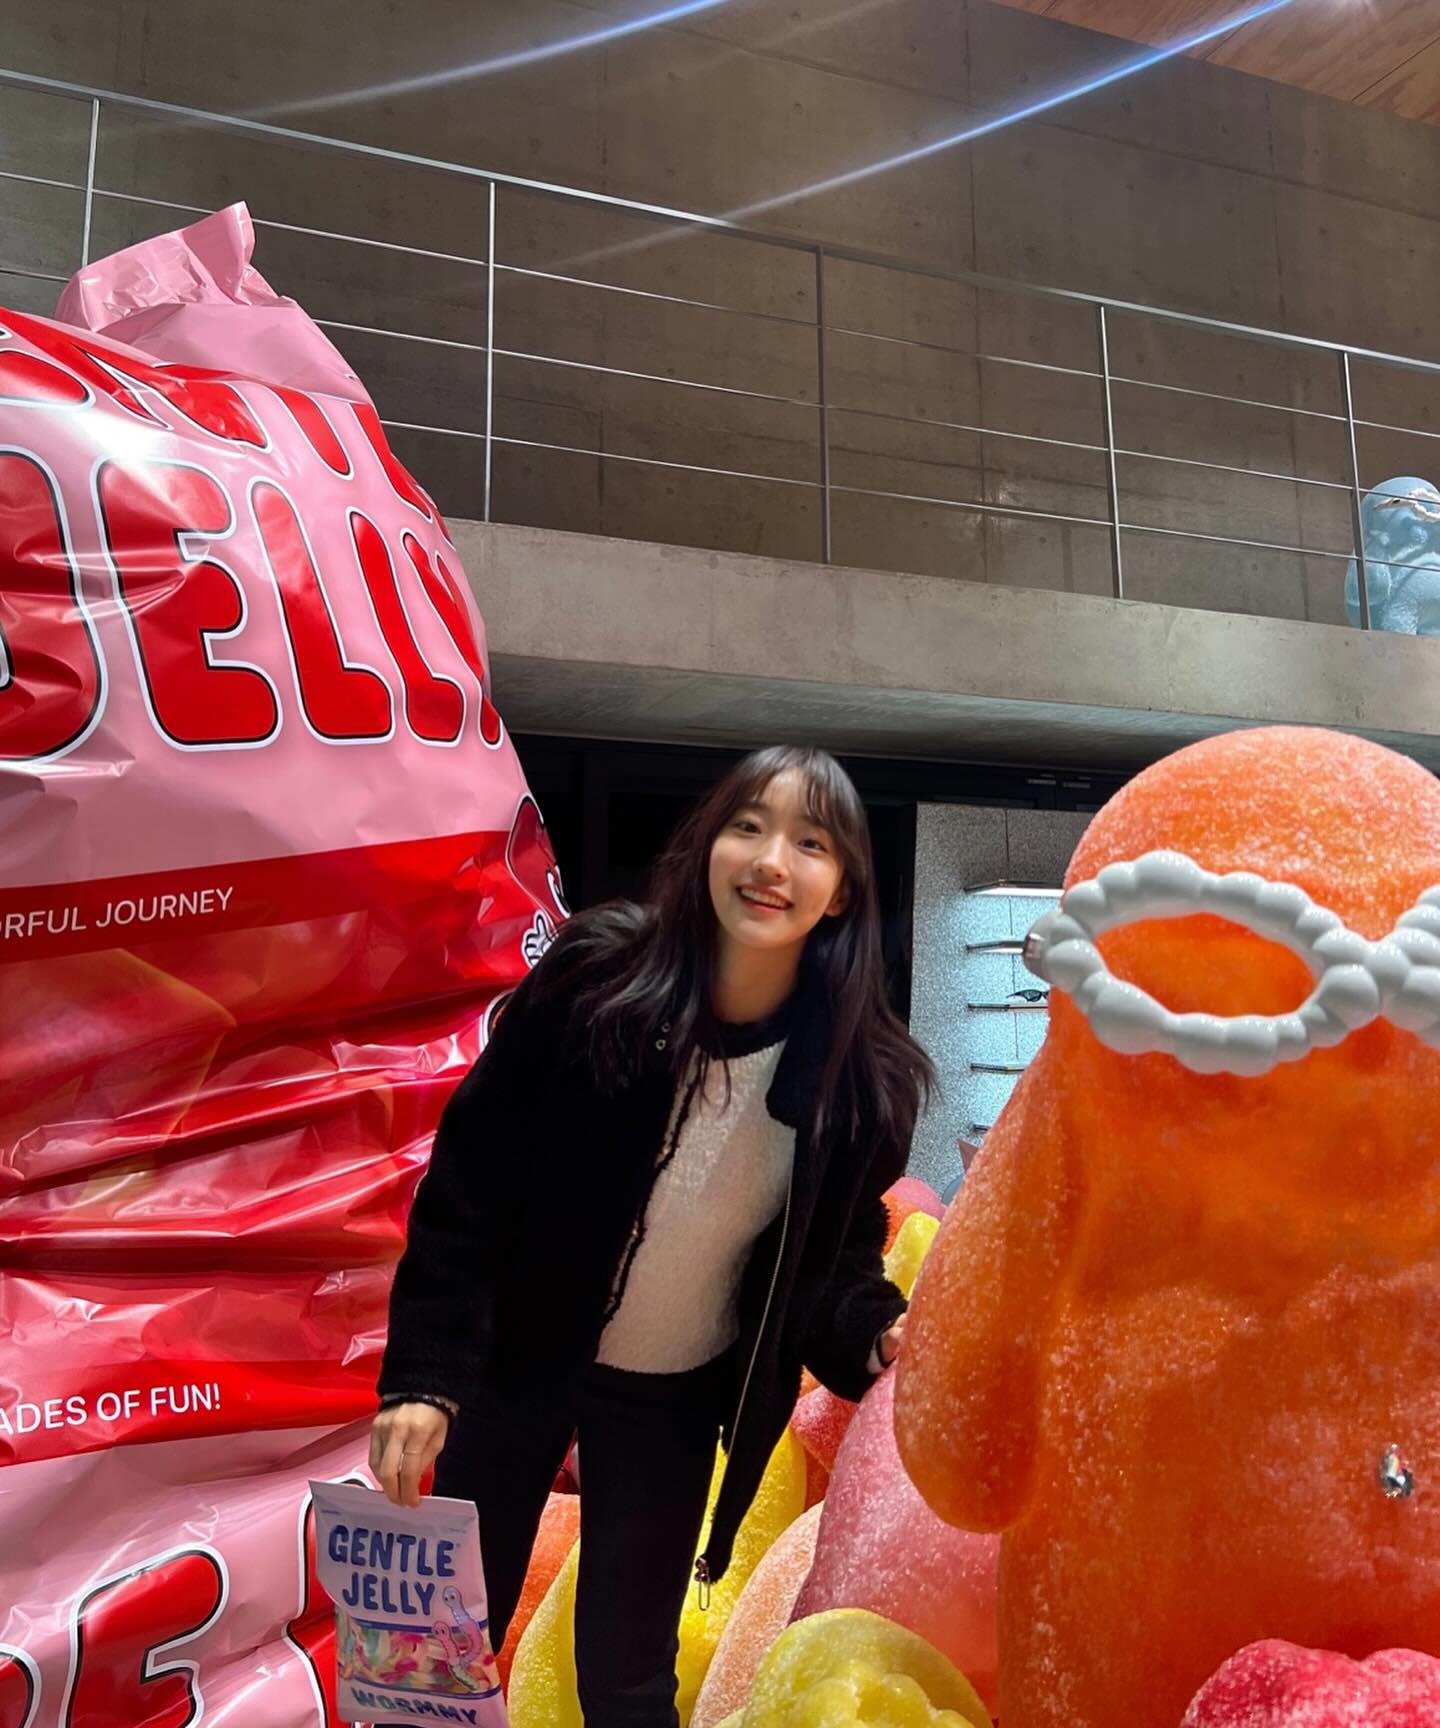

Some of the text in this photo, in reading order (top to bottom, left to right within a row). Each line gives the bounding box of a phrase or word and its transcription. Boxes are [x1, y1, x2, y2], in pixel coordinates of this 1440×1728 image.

[0, 886, 233, 939] RFUL JOURNEY
[96, 1389, 141, 1421] OF
[150, 1382, 221, 1416] FUN!
[328, 1525, 455, 1577] GENTLE
[342, 1571, 435, 1616] JELLY
